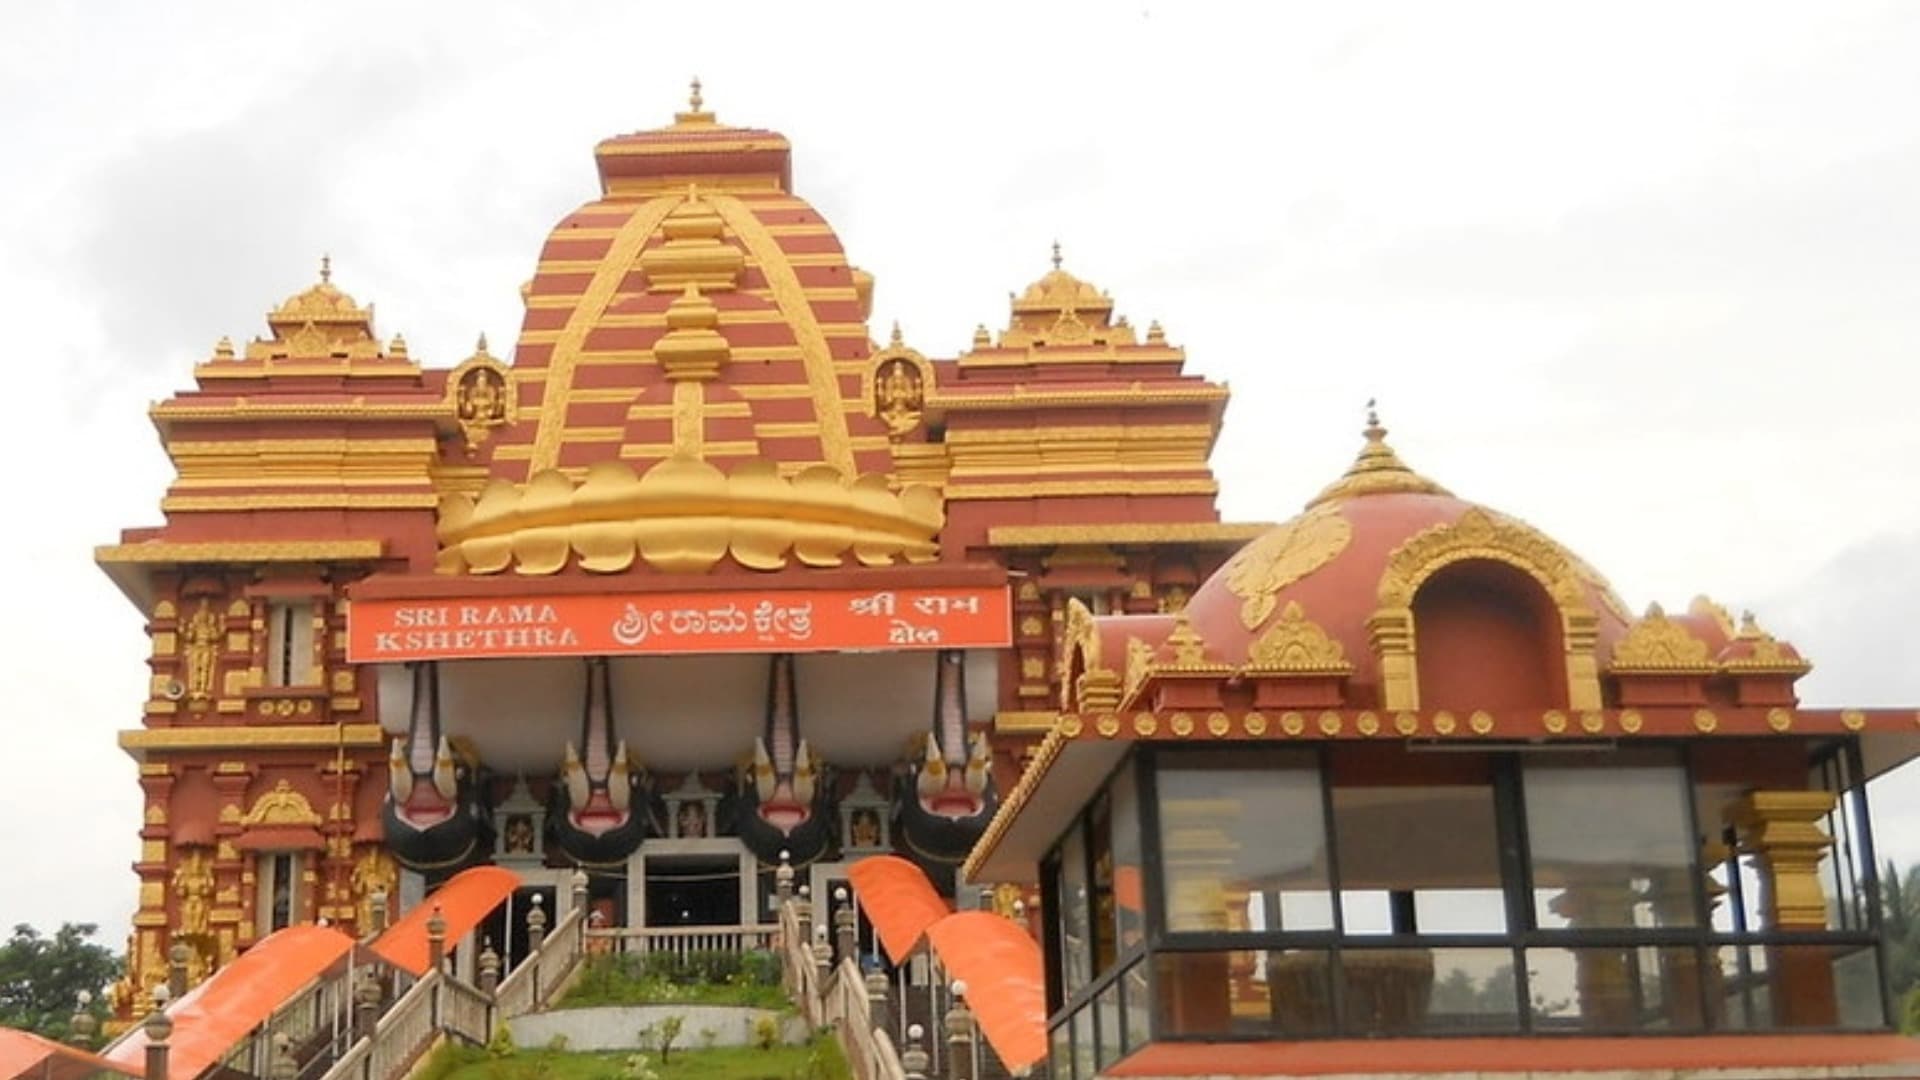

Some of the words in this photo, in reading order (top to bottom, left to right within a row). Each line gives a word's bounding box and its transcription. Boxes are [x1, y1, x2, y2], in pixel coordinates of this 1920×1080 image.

[395, 607, 447, 627] SRI
[461, 605, 558, 625] RAMA
[848, 592, 895, 616] श्री
[612, 602, 664, 646] ಶ್ರೀ
[670, 603, 748, 634] ರಾಮ
[375, 627, 578, 652] KSHETHRA
